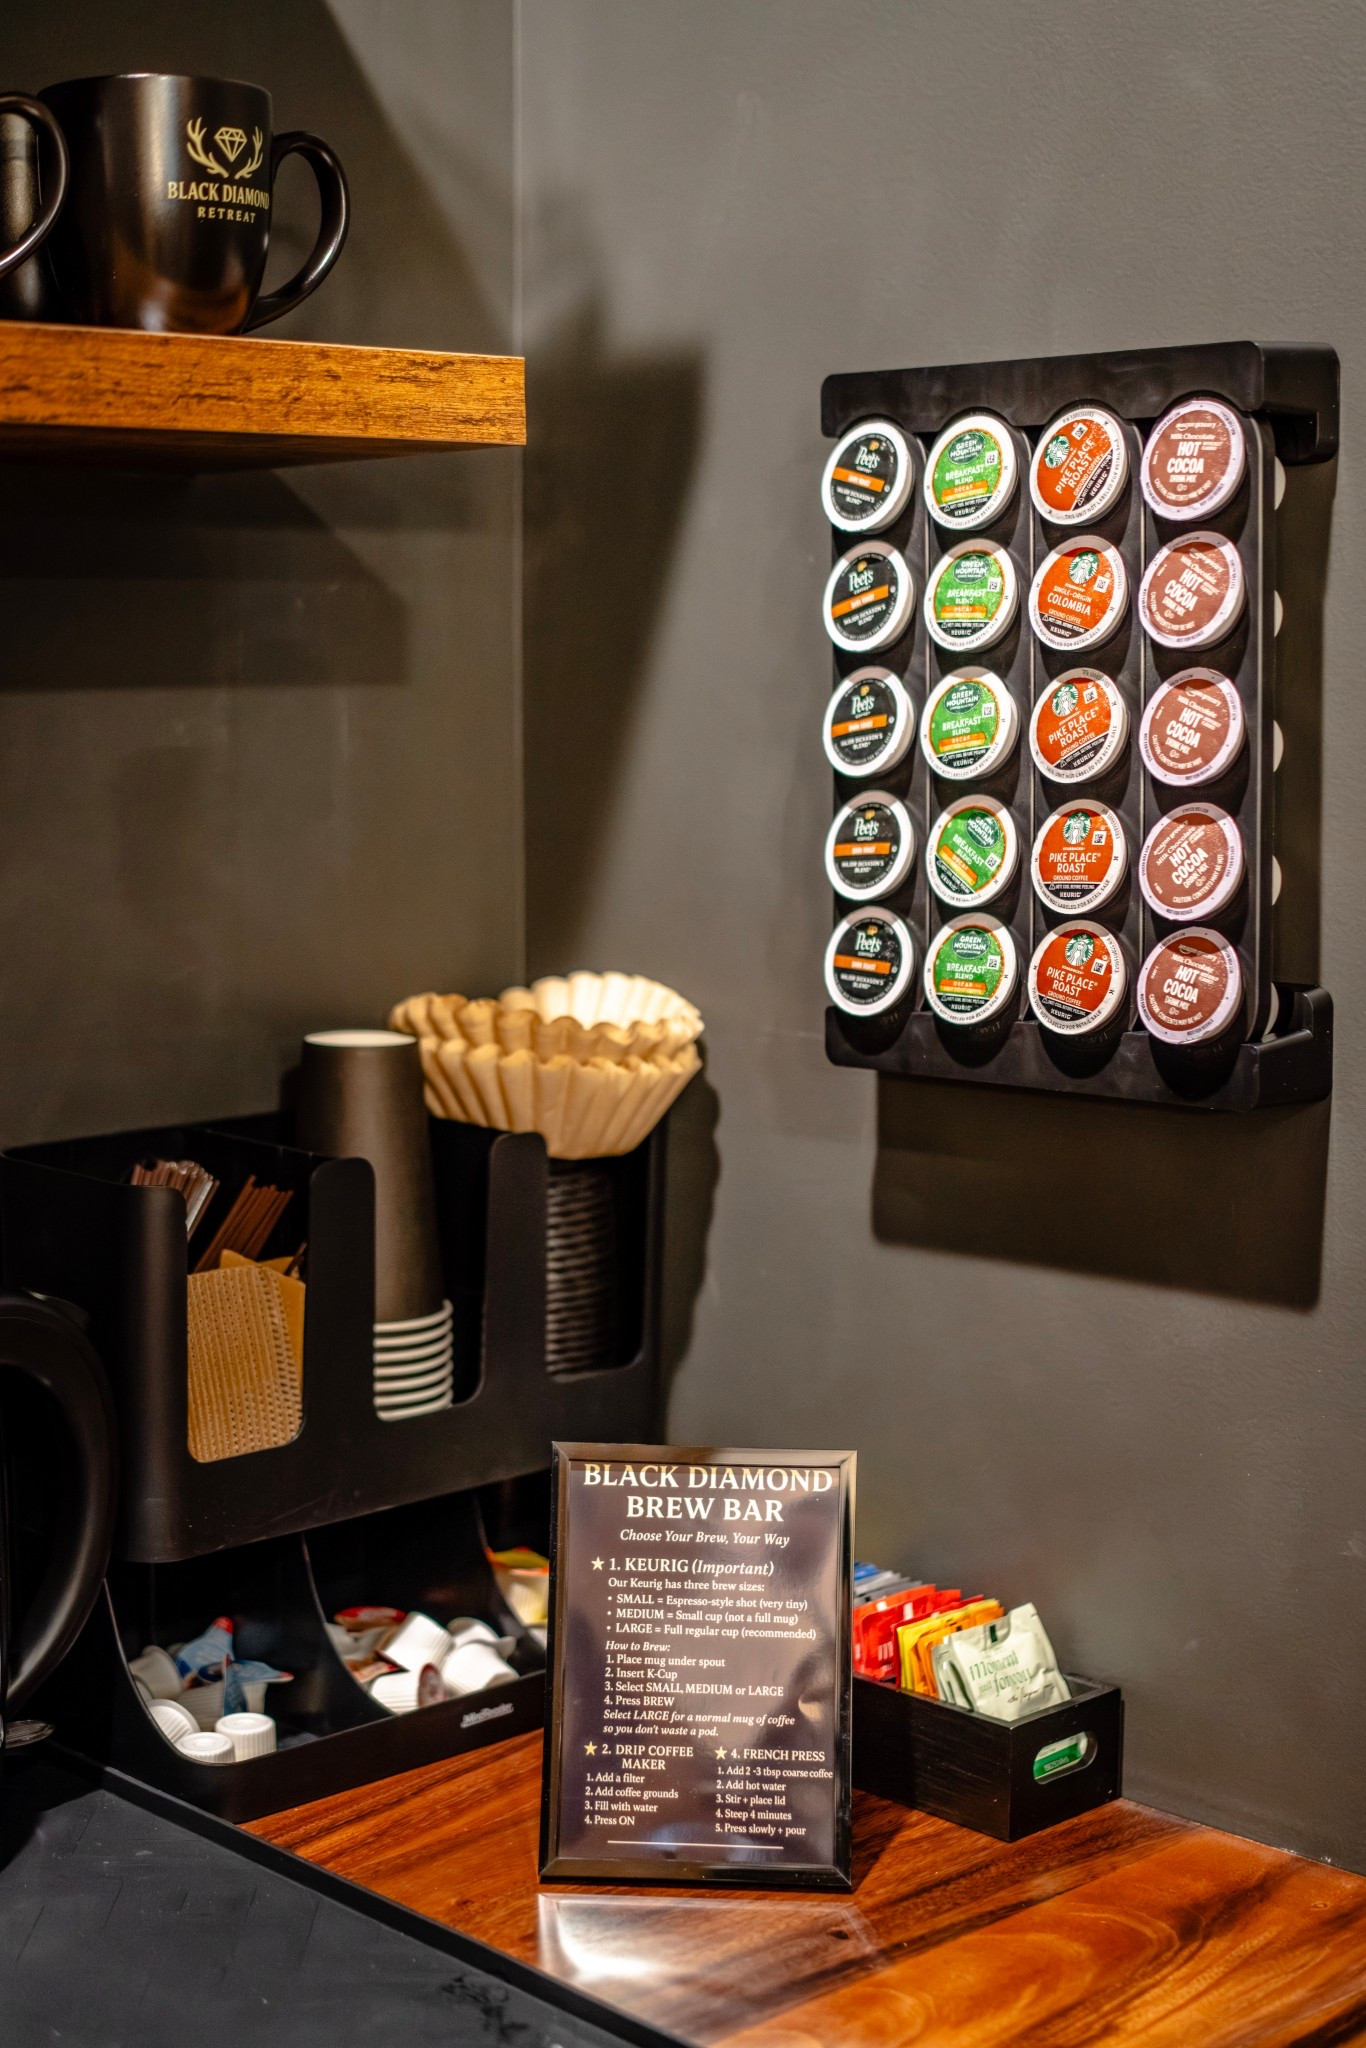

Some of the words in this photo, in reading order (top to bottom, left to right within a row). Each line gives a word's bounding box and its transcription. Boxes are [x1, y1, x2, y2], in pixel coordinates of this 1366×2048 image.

[168, 181, 219, 201] BLACK
[222, 185, 269, 209] DIAMOND
[198, 206, 256, 223] RETREAT
[1177, 442, 1201, 455] HOT
[1068, 454, 1092, 487] ROAST
[1167, 458, 1204, 473] COCOA
[1055, 471, 1073, 494] PIKE
[1180, 568, 1203, 590] HOT
[947, 589, 987, 598] BREAKFAST
[1053, 585, 1092, 603] SINGLE-ORIGIN
[1165, 580, 1199, 612] COCOA
[1047, 593, 1091, 615] COLOMBIA
[947, 696, 979, 707] MOUNTAIN
[952, 689, 973, 700] GREEN
[942, 715, 982, 731] BREAKFAST
[1179, 707, 1203, 727] HOT
[952, 727, 971, 735] BLEND
[1048, 726, 1067, 744] PIKE
[1060, 723, 1088, 747] ROAST
[1166, 720, 1201, 749] COCOA
[952, 834, 985, 867] BREAKFAST
[956, 849, 973, 865] BLEND
[1049, 853, 1067, 862] PIKE
[1169, 843, 1193, 868] HOT
[1057, 863, 1086, 873] ROAST
[1171, 848, 1208, 885] COCOA
[947, 963, 985, 974] BREAKFAST
[1047, 967, 1065, 981] PIKE
[1175, 965, 1199, 984] HOT
[1053, 980, 1081, 997] ROAST
[1163, 978, 1199, 1003] COCOA
[583, 1463, 677, 1488] BLACK
[688, 1466, 833, 1492] DIAMOND
[626, 1495, 712, 1519] BREW
[724, 1499, 784, 1522] BAR
[620, 1529, 662, 1542] Choose
[665, 1530, 693, 1543] Your
[696, 1532, 729, 1545] Brew,
[733, 1532, 761, 1545] Your
[764, 1533, 790, 1548] Way
[609, 1558, 621, 1571] 1.
[625, 1558, 689, 1573] KEURIG
[692, 1560, 774, 1576] (Important)
[608, 1578, 627, 1588] Our
[630, 1578, 662, 1591] Keurig
[665, 1579, 681, 1589] has
[684, 1580, 709, 1590] three
[712, 1581, 736, 1591] brew
[739, 1582, 765, 1592] sizes:
[617, 1594, 654, 1604] SMALL
[666, 1596, 734, 1608] Espresso-style
[736, 1598, 756, 1608] shot
[759, 1598, 783, 1610] (very
[786, 1599, 808, 1610] tiny)
[616, 1609, 664, 1619] MEDIUM
[676, 1611, 703, 1621] Small
[706, 1614, 722, 1623] cup
[725, 1612, 742, 1623] (not
[754, 1612, 771, 1623] full
[773, 1614, 798, 1625] mug)
[616, 1623, 652, 1634] LARGE
[664, 1624, 683, 1634] Full
[685, 1625, 719, 1637] regular
[722, 1629, 738, 1639] cup
[741, 1627, 816, 1640] (recommended)
[606, 1641, 626, 1651] How
[628, 1642, 640, 1651] to
[643, 1642, 670, 1652] Brew:
[607, 1654, 614, 1664] 1.
[617, 1654, 642, 1665] Place
[644, 1657, 666, 1667] mug
[669, 1656, 696, 1667] under
[699, 1657, 725, 1668] spout
[605, 1668, 614, 1678] 2.
[616, 1668, 644, 1679] Insert
[647, 1669, 677, 1680] K-Cup
[605, 1682, 613, 1691] 3.
[616, 1682, 643, 1692] Select
[646, 1683, 683, 1694] SMALL,
[685, 1684, 732, 1695] MEDIUM
[735, 1687, 745, 1695] or
[748, 1686, 784, 1696] LARGE
[604, 1696, 613, 1705] 4.
[616, 1696, 641, 1706] Press
[643, 1696, 675, 1707] BREW
[604, 1710, 631, 1720] Select
[633, 1711, 669, 1721] LARGE
[669, 1711, 684, 1724] for
[696, 1712, 731, 1723] normal
[733, 1716, 754, 1726] mug
[756, 1714, 768, 1725] of
[768, 1714, 795, 1727] coffee
[615, 1727, 633, 1736] you
[635, 1724, 659, 1735] don't
[661, 1726, 688, 1736] waste
[698, 1726, 719, 1738] pod.
[602, 1744, 612, 1754] 2.
[615, 1745, 645, 1755] DRIP
[648, 1745, 694, 1757] COFFEE
[731, 1749, 741, 1759] 4.
[744, 1749, 789, 1760] FRENCH
[792, 1751, 825, 1762] PRESS
[622, 1758, 666, 1770] MAKER
[586, 1773, 594, 1782] 1.
[595, 1773, 613, 1782] Add
[623, 1774, 645, 1784] filter
[717, 1780, 724, 1789] 2.
[726, 1781, 745, 1790] Add
[747, 1781, 760, 1790] hot
[762, 1782, 786, 1791] water
[586, 1787, 594, 1795] 2.
[595, 1787, 614, 1796] Add
[615, 1787, 641, 1797] coffee
[643, 1788, 678, 1800] grounds
[585, 1801, 593, 1810] 3.
[595, 1801, 609, 1810] Fill
[611, 1802, 630, 1811] with
[633, 1803, 658, 1812] water
[585, 1815, 593, 1824] 4.
[594, 1815, 617, 1826] Press
[619, 1816, 635, 1826] ON
[716, 1810, 723, 1818] 4.
[725, 1810, 748, 1821] Steep
[750, 1810, 756, 1819] 4
[758, 1811, 792, 1820] minutes
